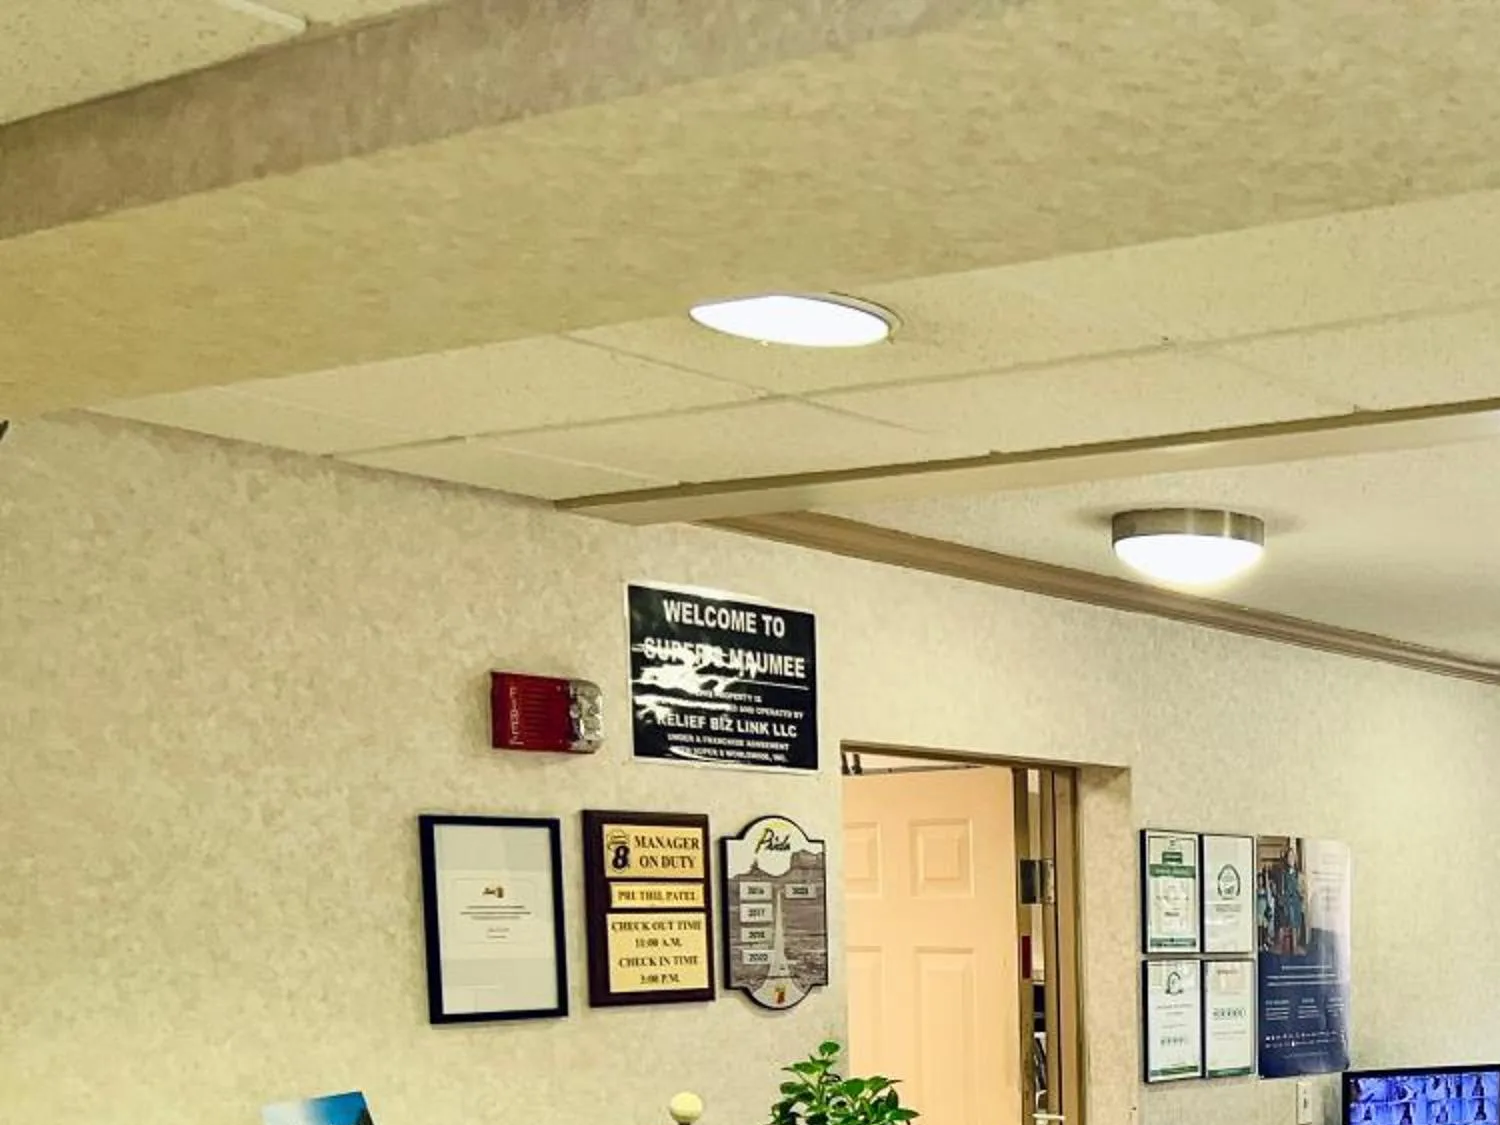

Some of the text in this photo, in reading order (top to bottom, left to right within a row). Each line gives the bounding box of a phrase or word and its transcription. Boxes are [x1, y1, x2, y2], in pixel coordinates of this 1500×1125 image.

[663, 599, 785, 638] WELCOME TO
[729, 647, 806, 679] MAUMEE
[657, 712, 707, 729] RELIEF
[737, 719, 770, 736] LINK
[773, 723, 798, 738] LLC
[634, 835, 700, 850] MANAGER
[640, 856, 696, 869] ON DUTY
[611, 920, 702, 932] CHECK OUT TIME
[618, 955, 698, 968] CHECK IN TIME
